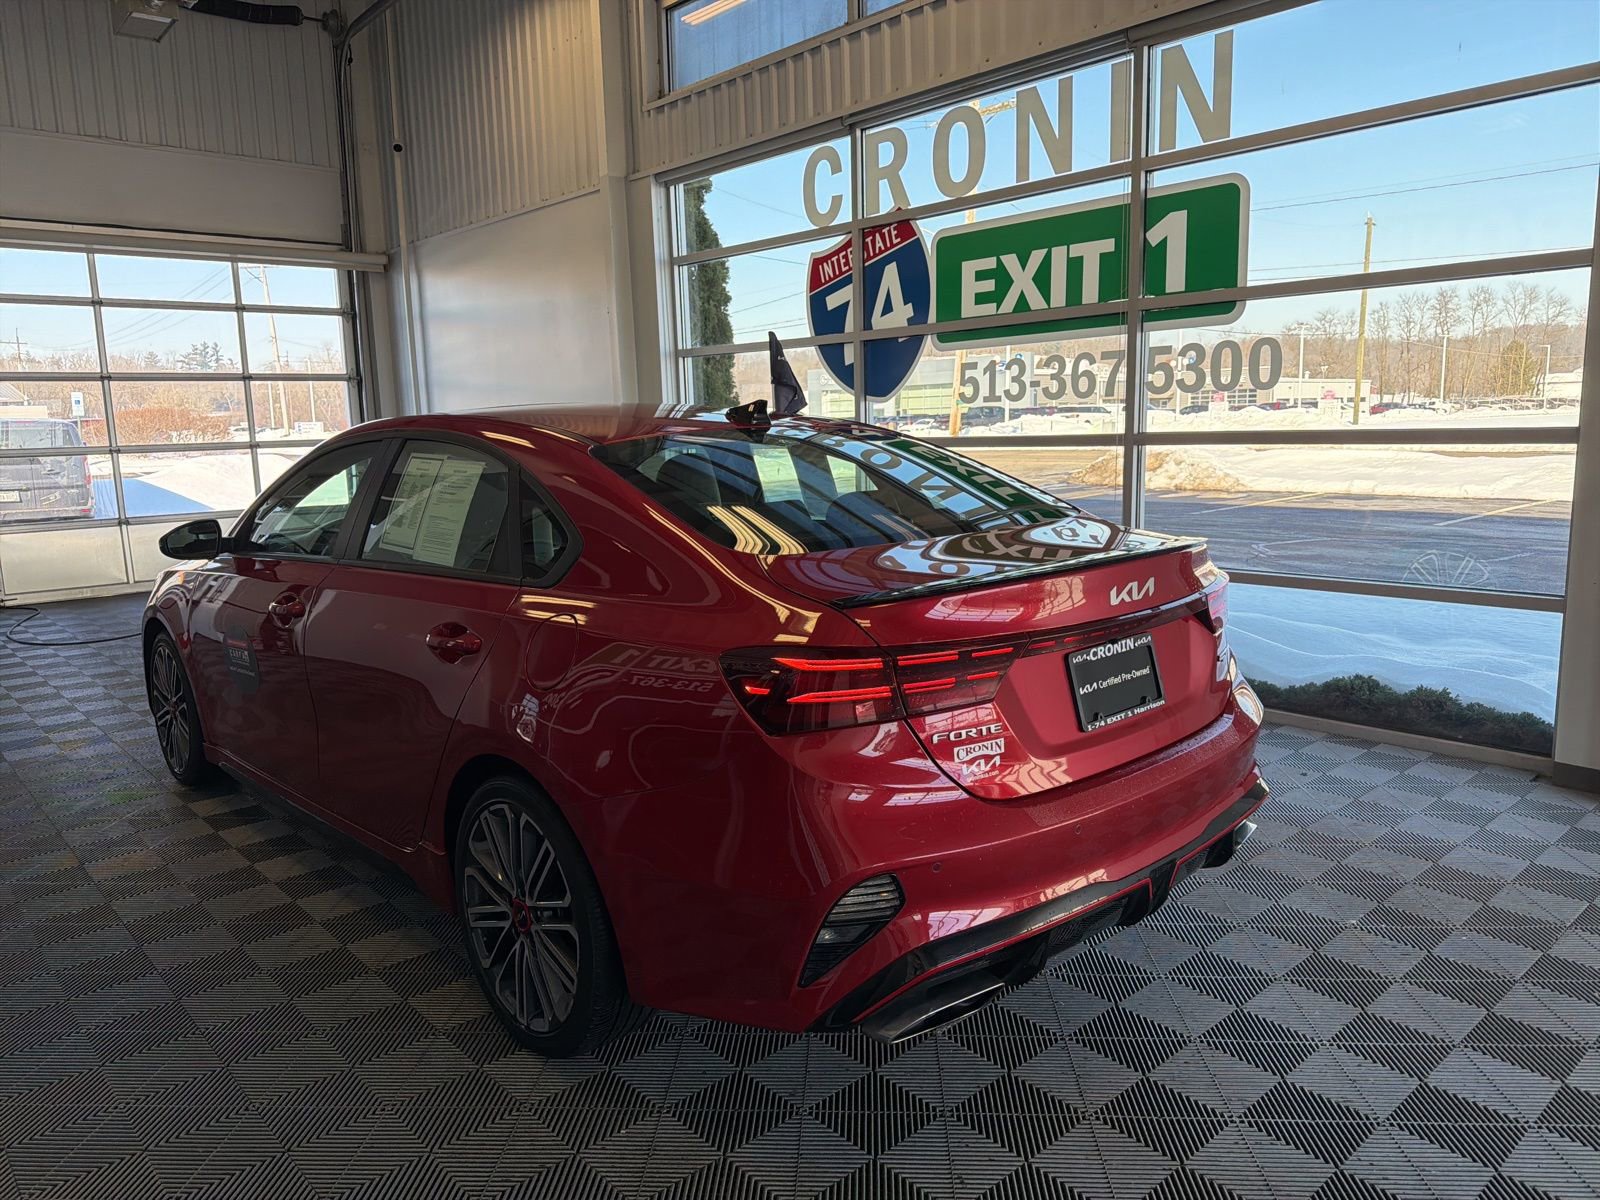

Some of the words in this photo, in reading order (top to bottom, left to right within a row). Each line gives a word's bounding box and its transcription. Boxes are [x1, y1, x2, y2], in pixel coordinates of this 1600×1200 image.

[803, 29, 1234, 228] CRONIN
[819, 223, 901, 284] INTERTATE
[961, 238, 1116, 319] EXIT
[1145, 209, 1189, 293] 1
[825, 261, 914, 366] 74
[959, 337, 1283, 405] 513-3675300
[1109, 576, 1155, 606] KIA
[1089, 637, 1134, 661] CRONIN
[1080, 682, 1098, 695] KIA
[1098, 673, 1122, 689] Certified
[1122, 665, 1150, 682] Pre-Owned
[1087, 720, 1105, 732] I-74
[1107, 713, 1126, 724] EXIT
[1134, 699, 1165, 715] Harrison
[932, 722, 1003, 745] FORTE
[956, 739, 1002, 761] CRONIN
[961, 755, 1000, 776] KIA
